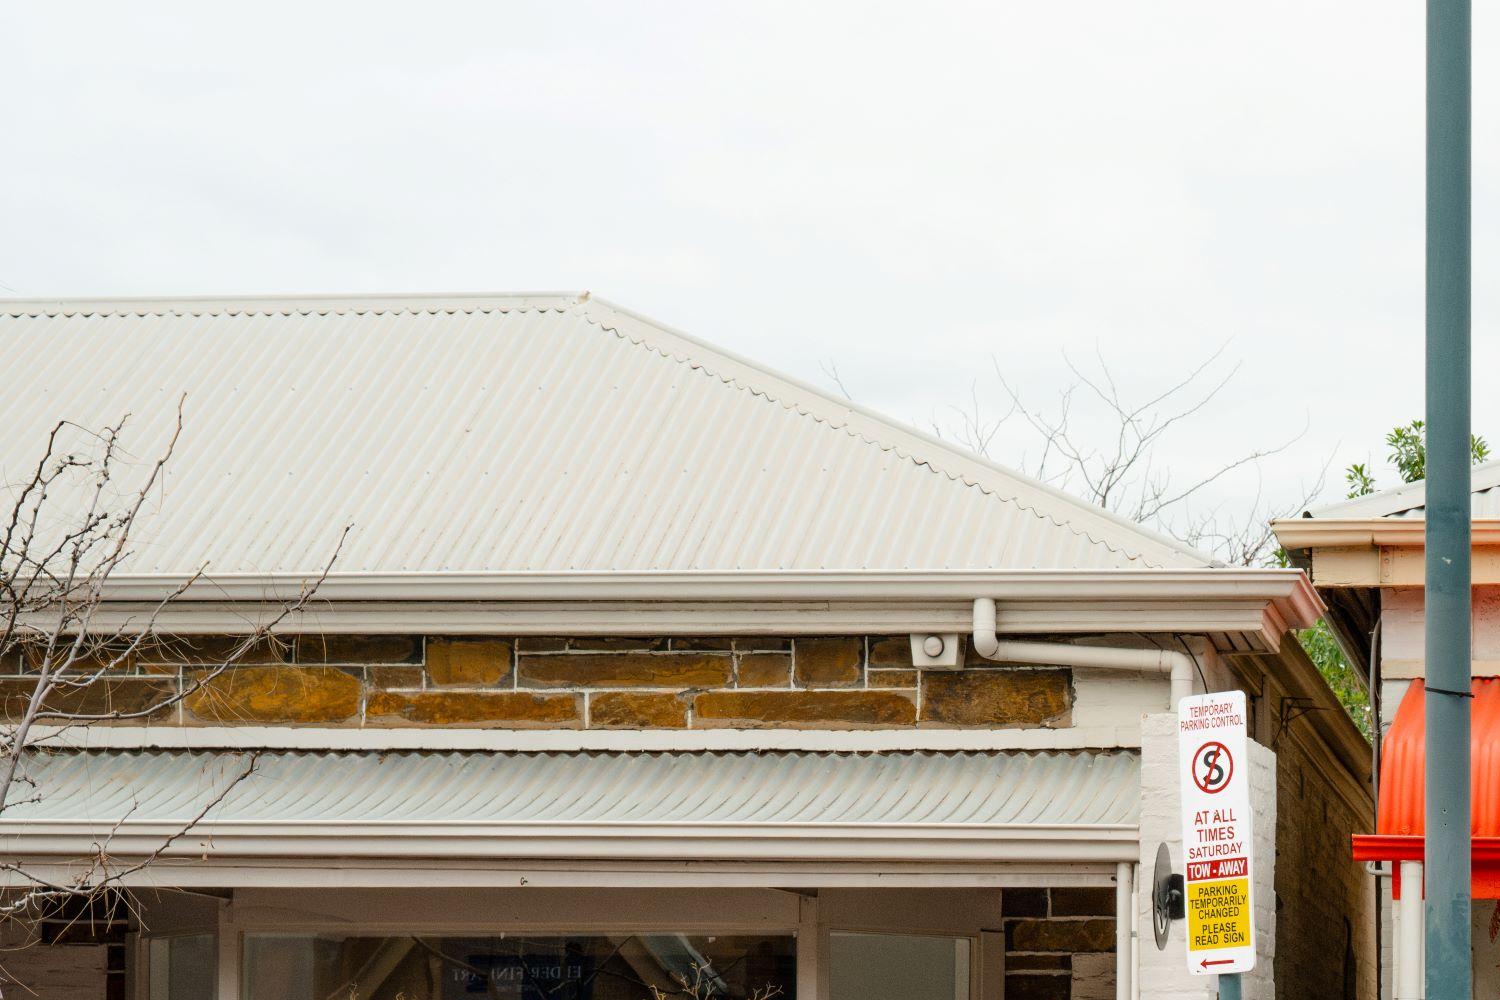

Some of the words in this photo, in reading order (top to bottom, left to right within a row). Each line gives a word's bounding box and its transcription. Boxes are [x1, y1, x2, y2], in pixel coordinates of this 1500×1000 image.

[1190, 702, 1233, 718] TEMPORARY
[1180, 717, 1210, 732] PARKING
[1211, 714, 1244, 728] CONTROL
[1194, 810, 1209, 826] AT
[1213, 808, 1236, 823] ALL
[1197, 826, 1234, 842] TIMES
[1189, 842, 1242, 859] SATURDAY
[1189, 863, 1211, 879] TOW
[1218, 860, 1246, 875] AWAY
[1198, 885, 1238, 897] PARKING
[1190, 894, 1246, 909] TEMPORARILY
[1198, 907, 1240, 920] CHANGED
[1202, 922, 1237, 934] PLEASE
[1195, 934, 1218, 946] READ
[1224, 932, 1244, 944] SIGN
